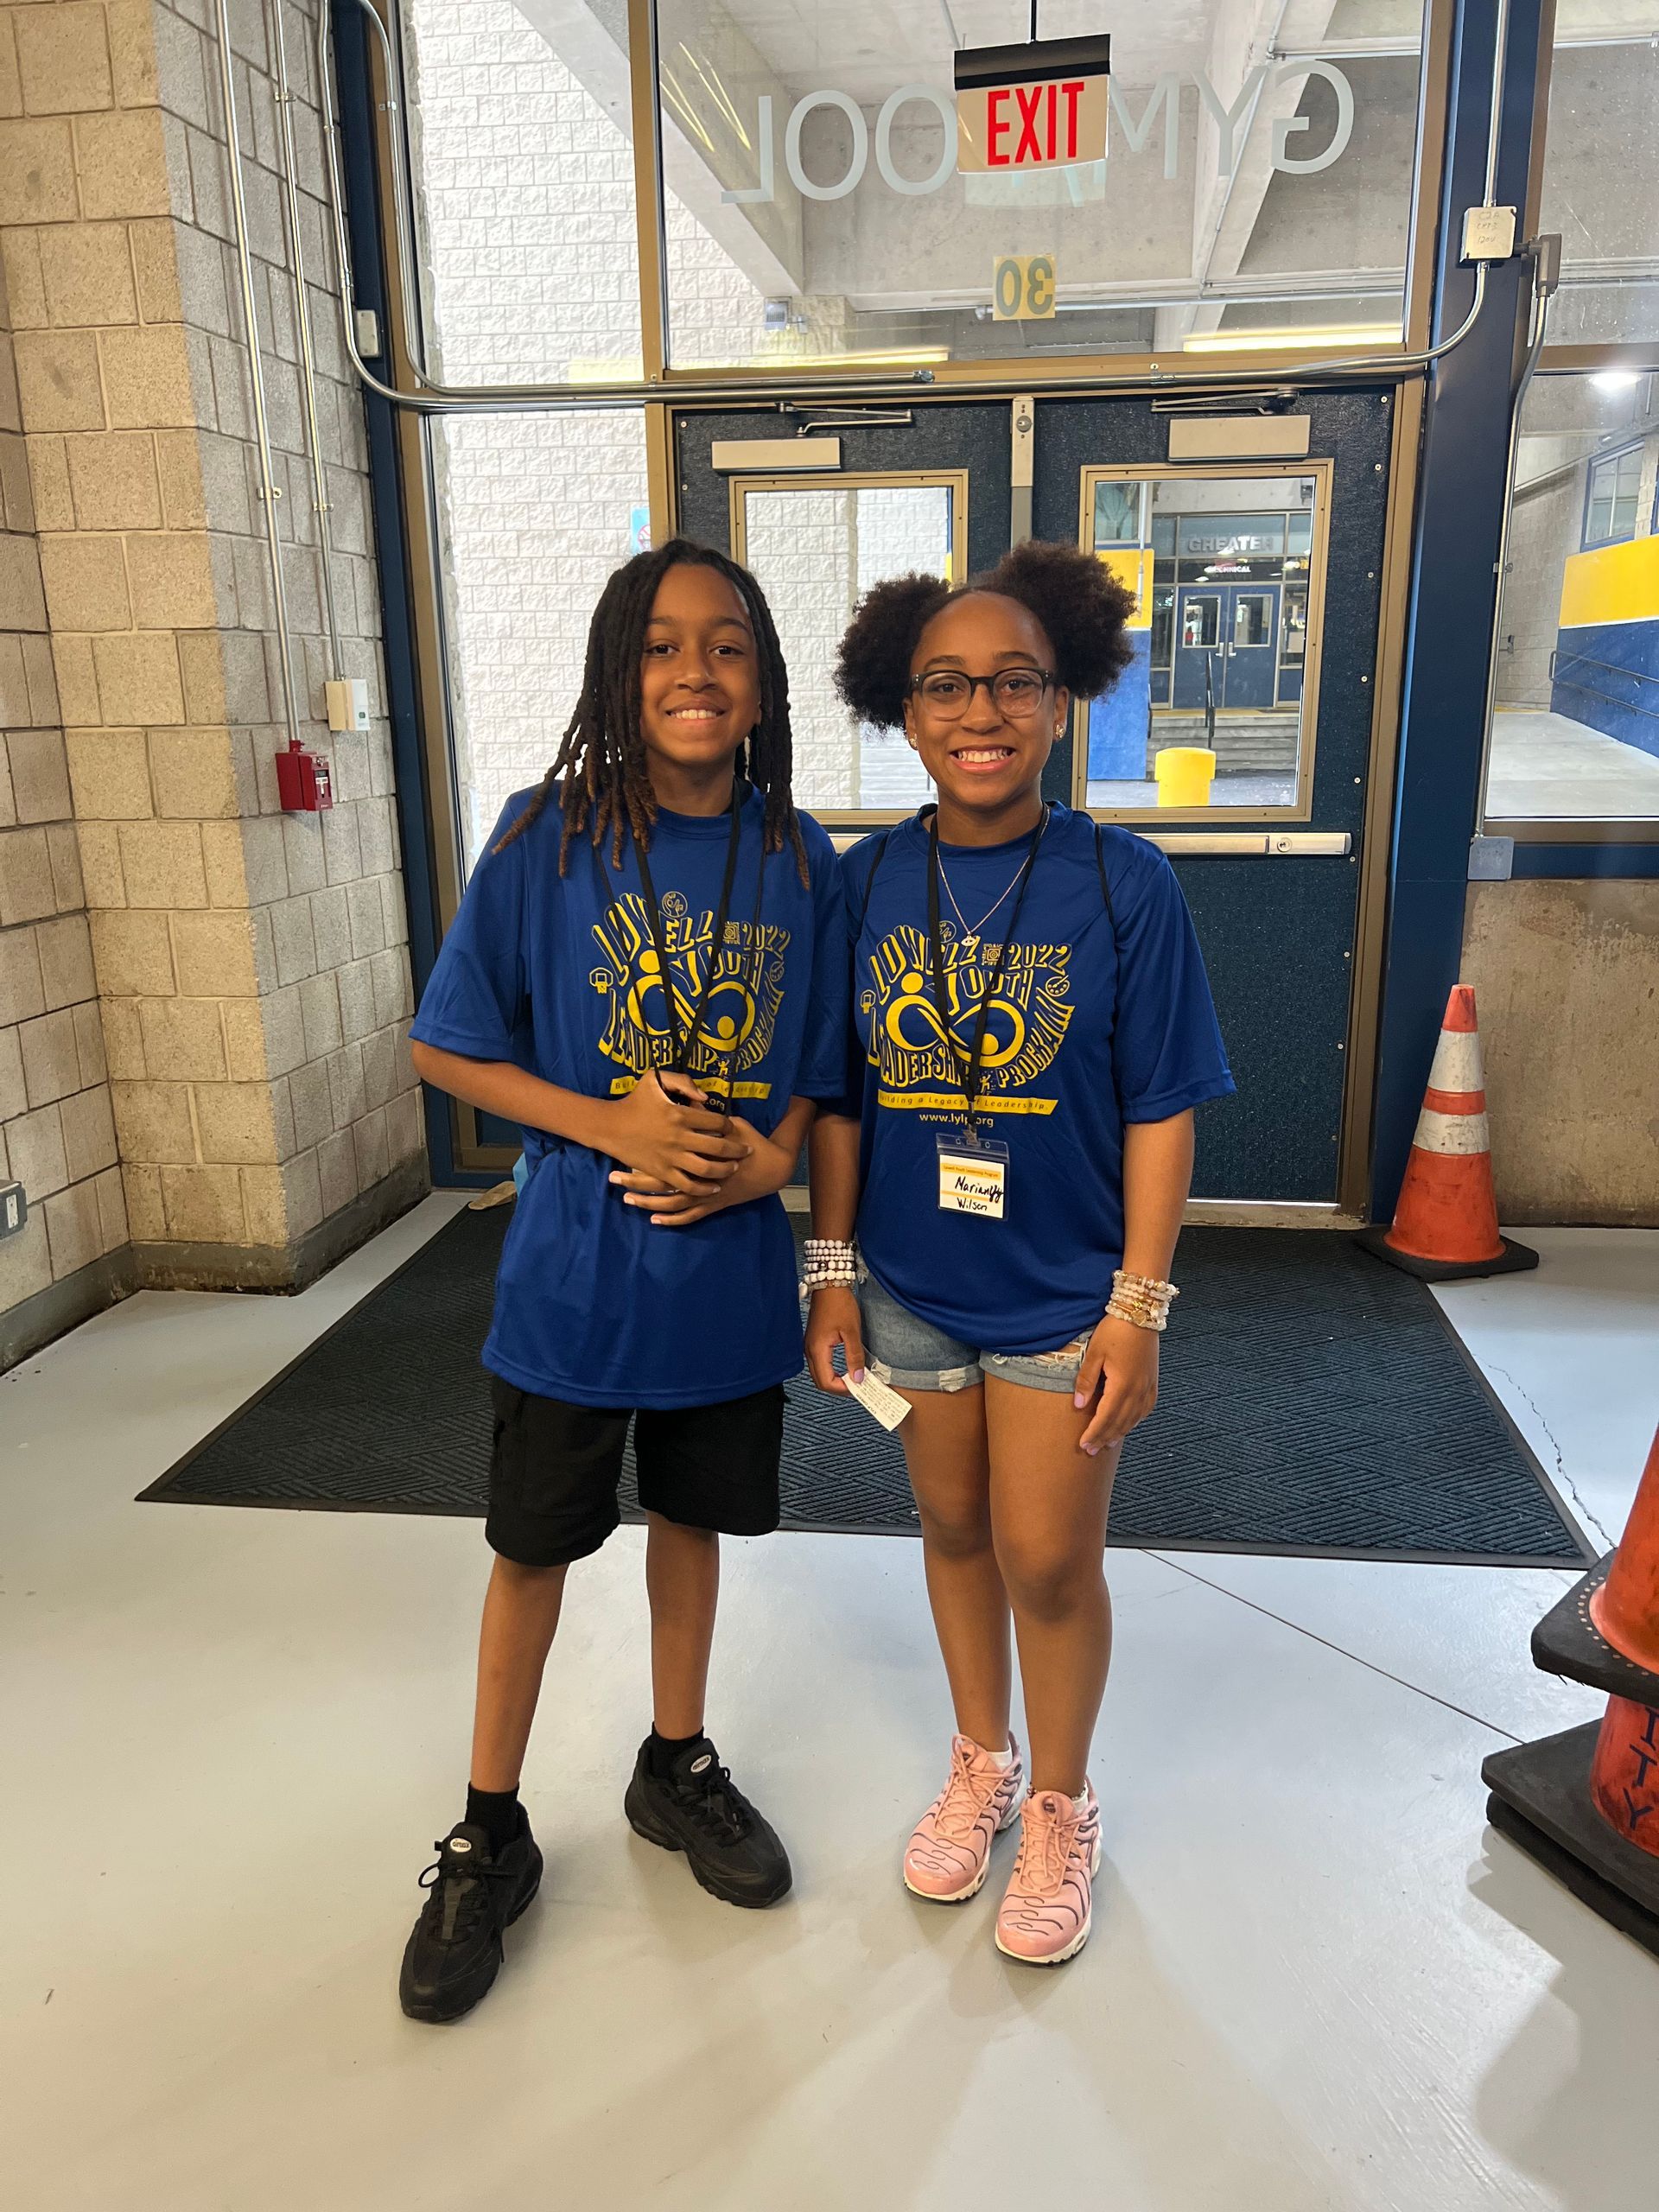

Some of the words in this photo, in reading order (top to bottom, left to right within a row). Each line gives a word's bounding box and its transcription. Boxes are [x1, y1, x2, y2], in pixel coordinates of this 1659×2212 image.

[987, 81, 1084, 167] EXIT
[1188, 534, 1273, 552] GREATER
[741, 920, 791, 961] 2022
[1007, 942, 1072, 976] 2022
[598, 988, 720, 1075] LEADERIP
[995, 987, 1075, 1088] PROGRAM
[880, 1095, 913, 1106] uilding
[929, 1096, 963, 1107] Legacy
[918, 1113, 994, 1128] www.lylorg
[957, 1197, 988, 1211] Wilson
